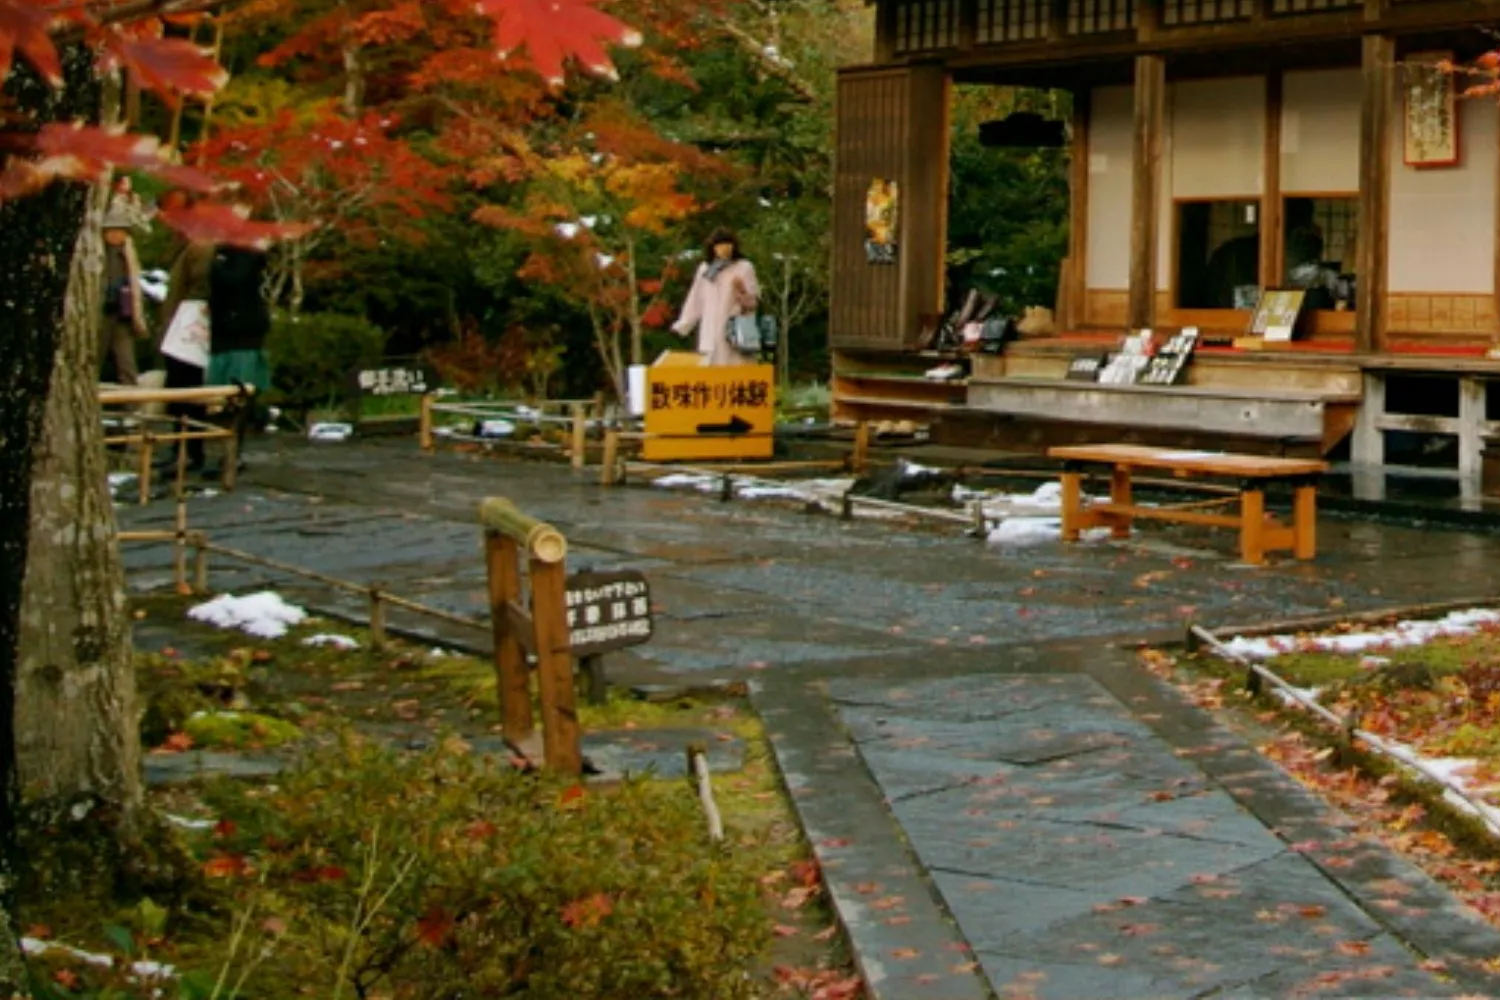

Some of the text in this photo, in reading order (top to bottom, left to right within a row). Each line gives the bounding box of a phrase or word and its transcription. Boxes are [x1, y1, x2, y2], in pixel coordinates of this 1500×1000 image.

[651, 379, 769, 409] 数珠作り体験
